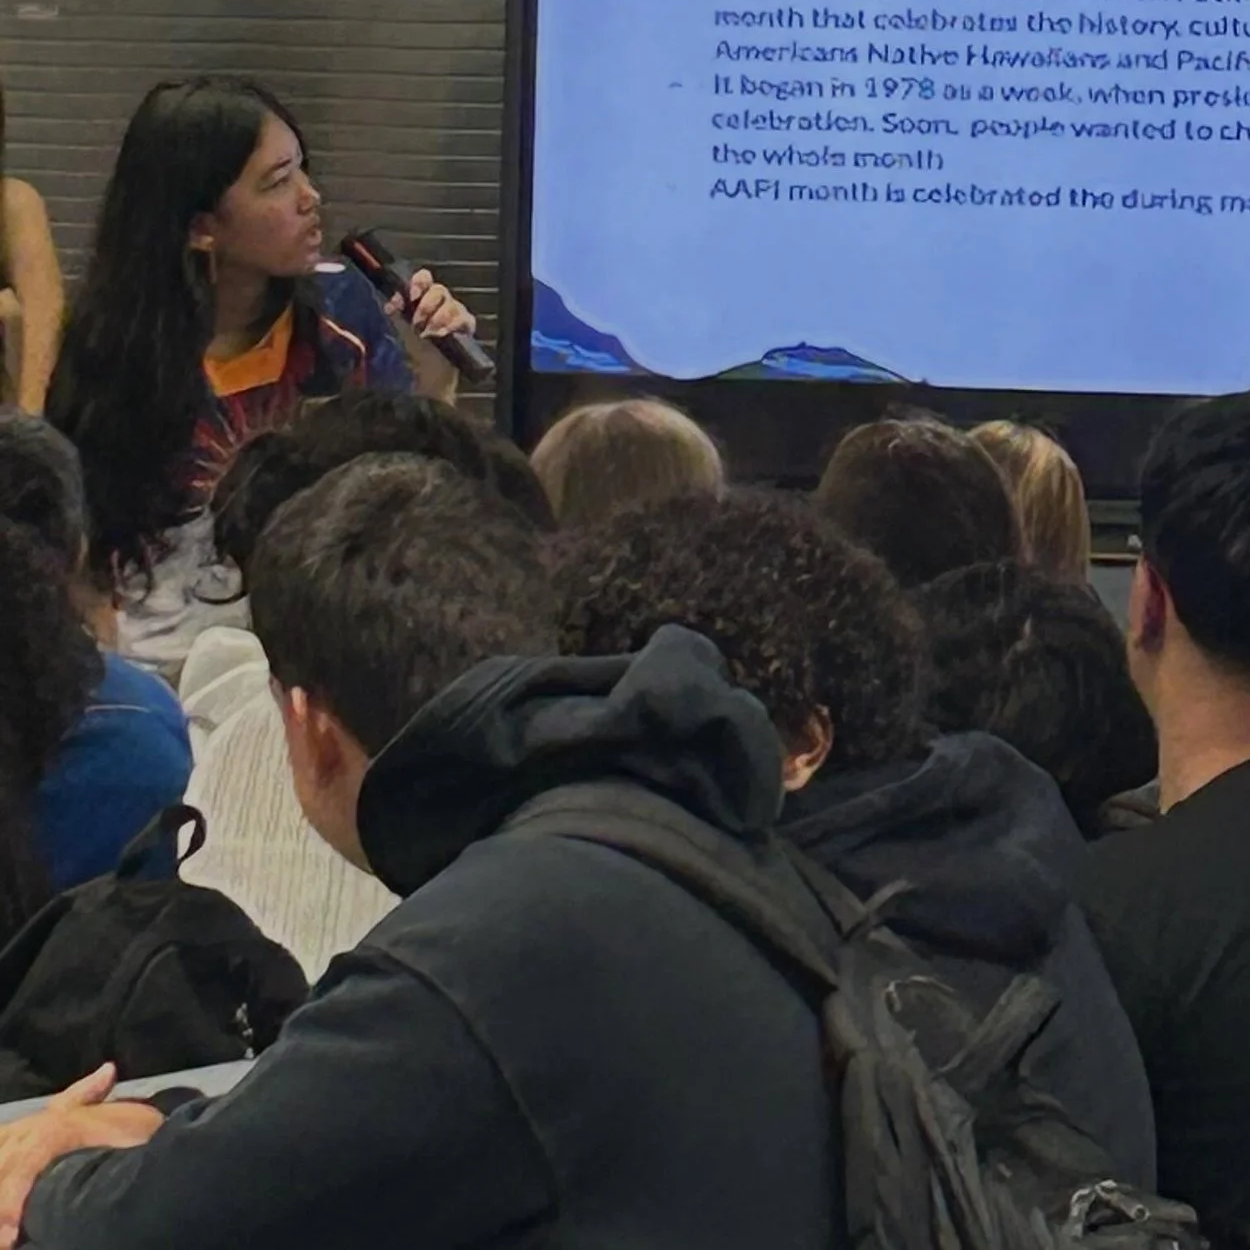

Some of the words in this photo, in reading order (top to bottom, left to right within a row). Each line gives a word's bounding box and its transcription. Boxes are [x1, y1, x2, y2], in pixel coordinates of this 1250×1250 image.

[715, 8, 803, 29] month
[812, 7, 865, 29] that
[1028, 11, 1072, 34] the
[868, 43, 959, 66] Native
[1116, 49, 1167, 70] and
[740, 75, 823, 101] began
[831, 78, 856, 98] in
[865, 77, 935, 100] 1978
[1089, 83, 1165, 104] when
[1070, 119, 1176, 140] wanted
[1186, 121, 1213, 141] to
[712, 144, 756, 165] the
[763, 145, 846, 167] whole
[853, 149, 944, 170] month
[789, 182, 877, 202] month
[1070, 188, 1114, 209] the
[1122, 189, 1213, 215] during
